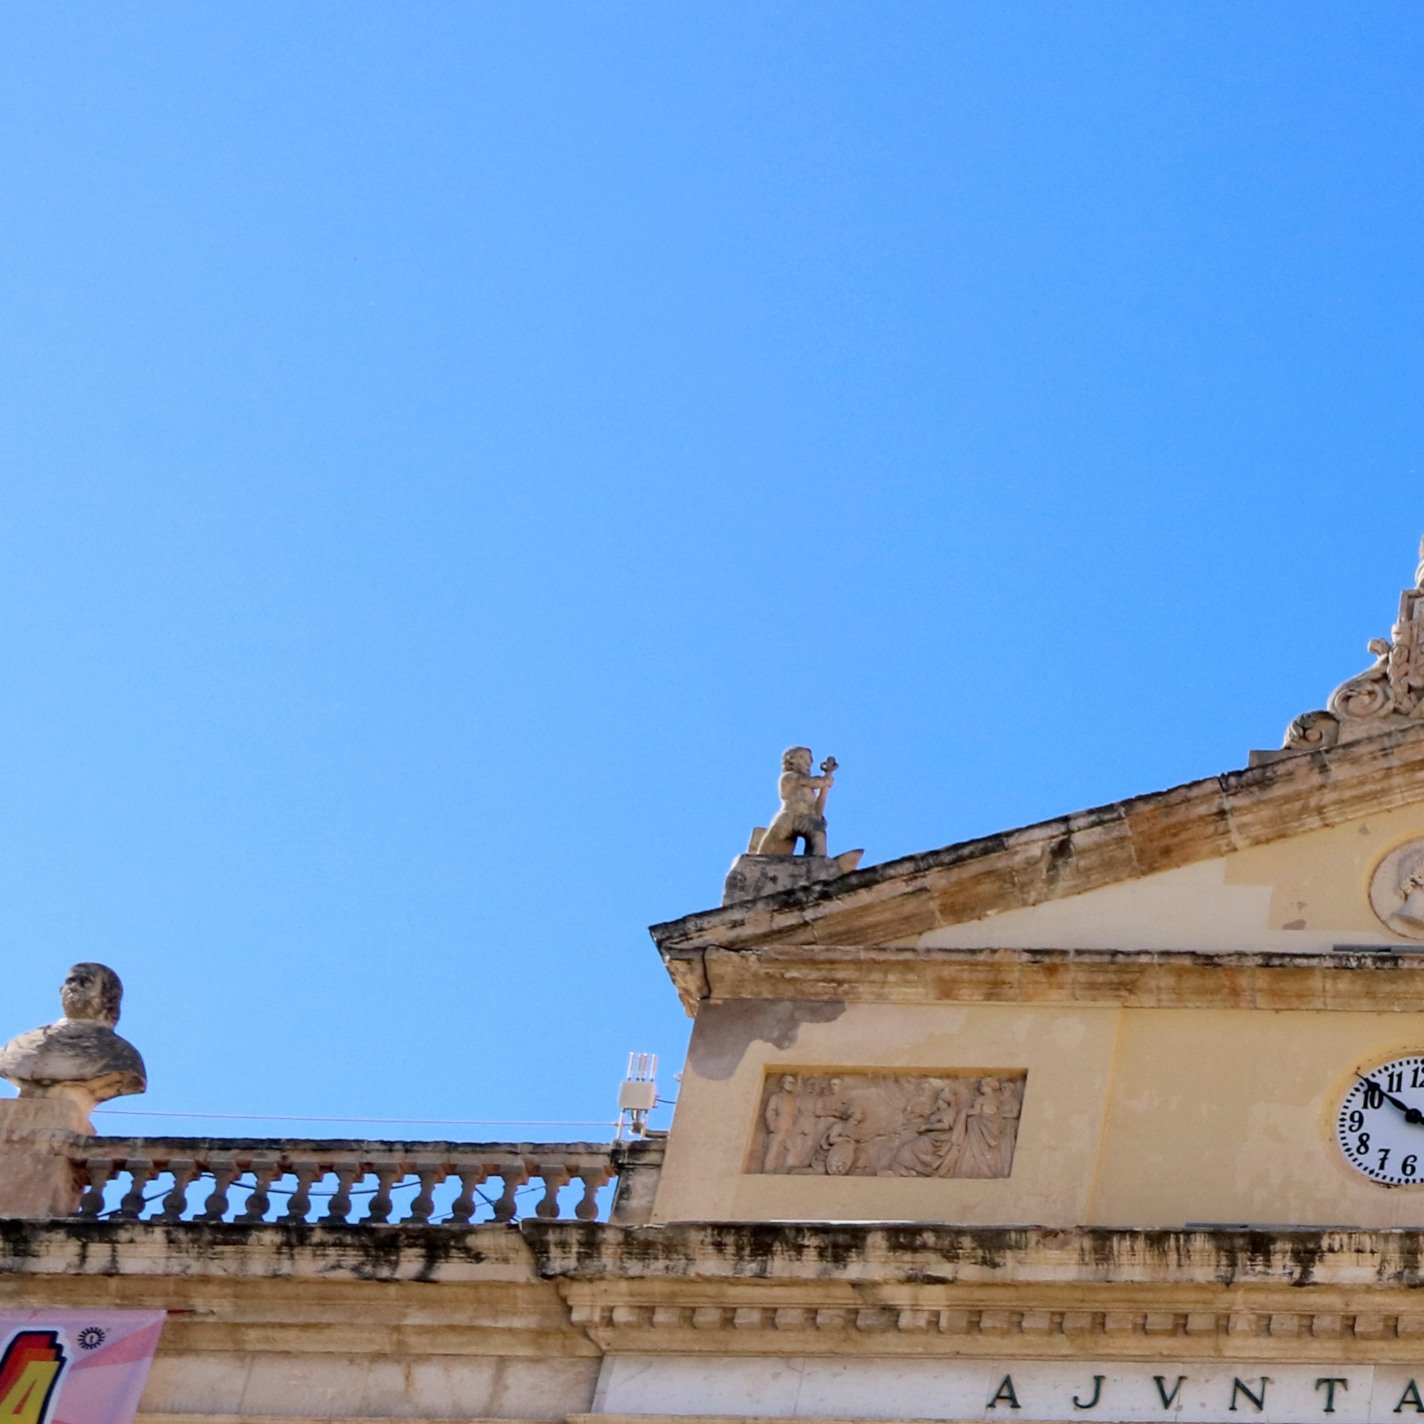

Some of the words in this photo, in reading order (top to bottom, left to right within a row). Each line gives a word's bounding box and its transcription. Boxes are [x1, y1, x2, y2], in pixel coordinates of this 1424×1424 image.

[1387, 1071, 1403, 1093] 11
[1362, 1087, 1384, 1109] 10
[1348, 1110, 1364, 1133] 9
[1356, 1132, 1370, 1155] 8
[1378, 1148, 1391, 1171] 7
[1401, 1155, 1417, 1176] 6
